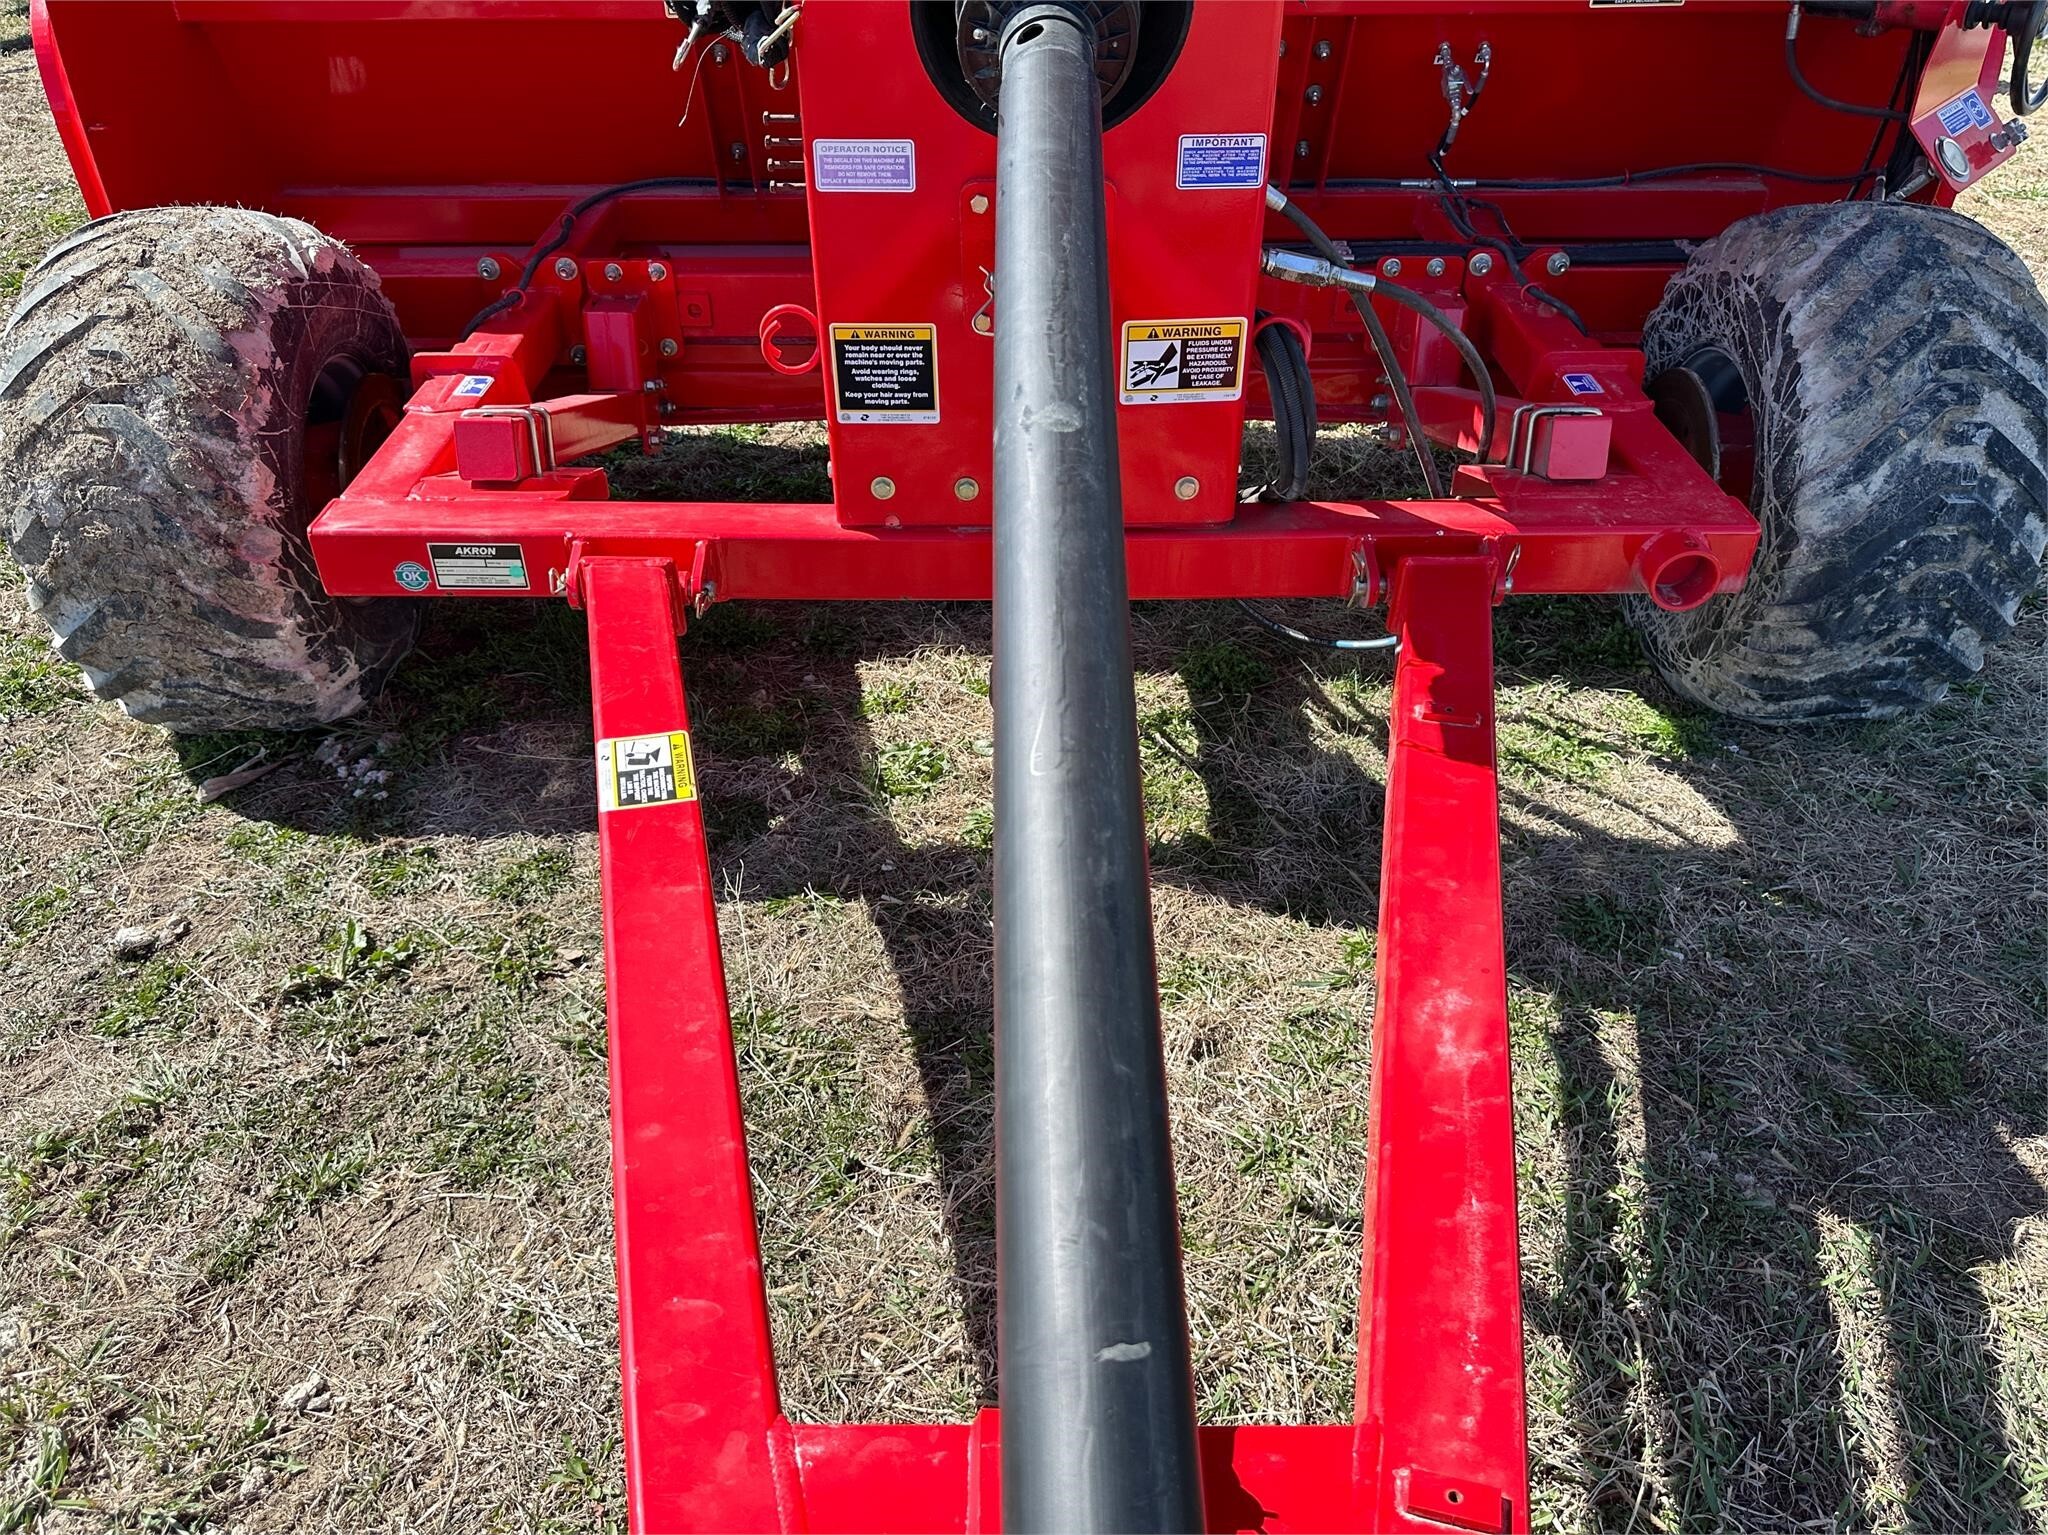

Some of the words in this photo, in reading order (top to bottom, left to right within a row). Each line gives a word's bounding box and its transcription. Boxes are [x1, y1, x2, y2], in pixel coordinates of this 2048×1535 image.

[1162, 327, 1222, 337] WARNING
[455, 547, 496, 555] AKRON
[402, 572, 422, 581] OK
[675, 752, 687, 788] WARNING
